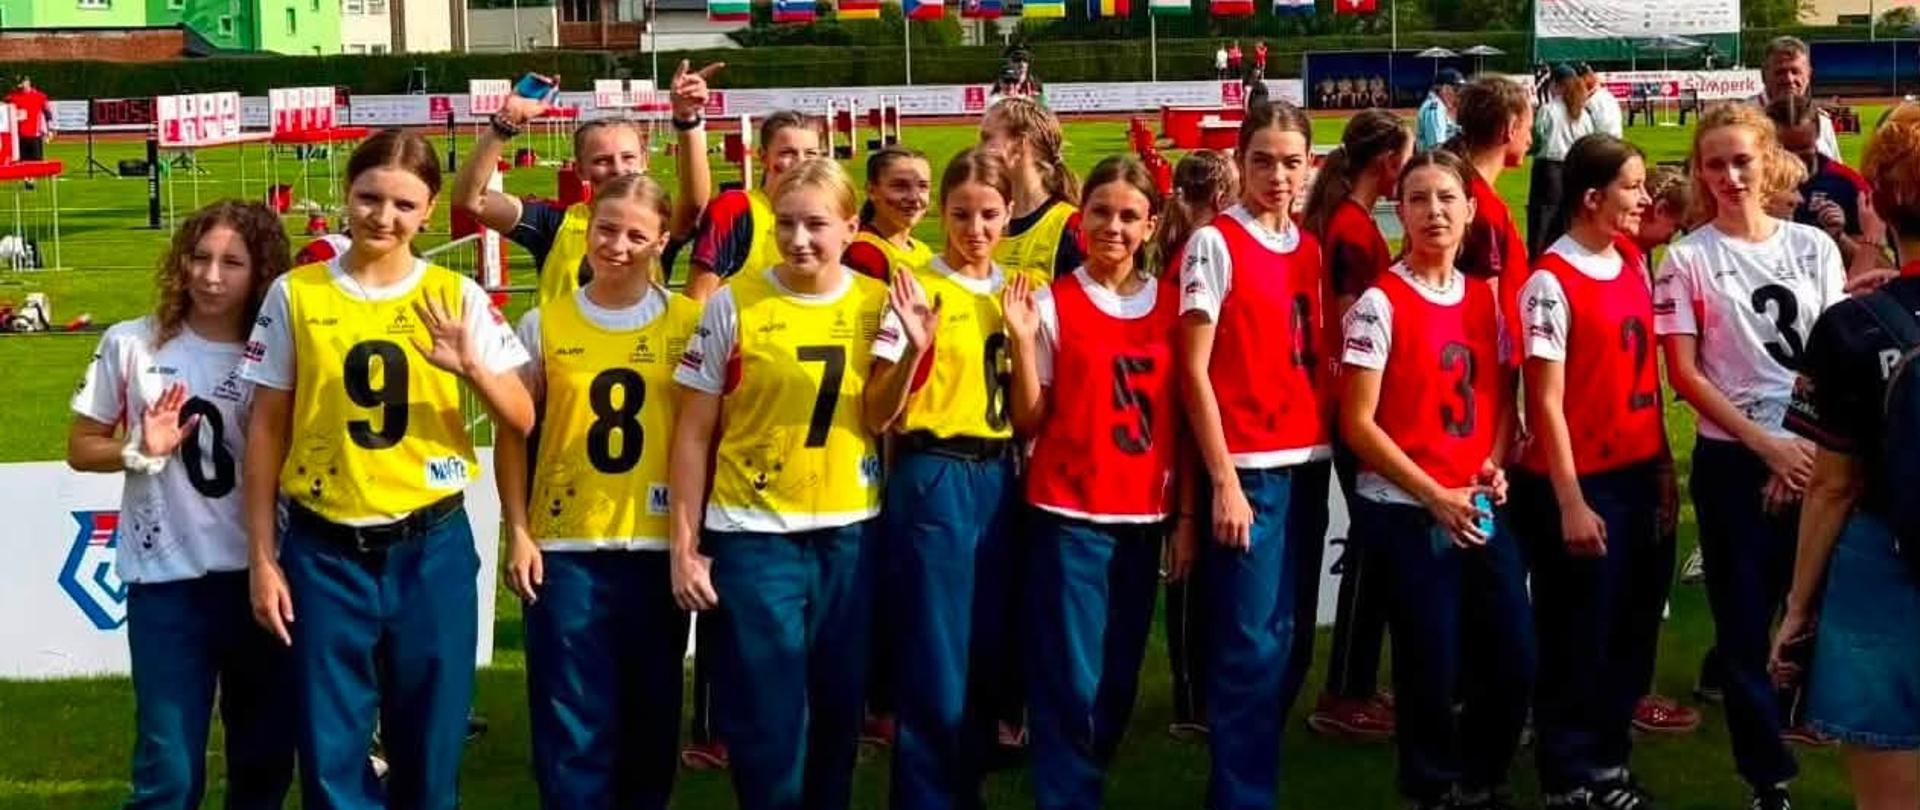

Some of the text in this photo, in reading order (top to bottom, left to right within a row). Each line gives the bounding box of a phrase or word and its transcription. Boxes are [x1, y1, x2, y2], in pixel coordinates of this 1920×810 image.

[1620, 317, 1658, 412] 2
[1751, 284, 1804, 370] 3
[344, 339, 409, 450] 9
[587, 367, 646, 474] 8
[796, 344, 845, 448] 7
[1113, 354, 1154, 455] 5
[1439, 342, 1476, 438] 3
